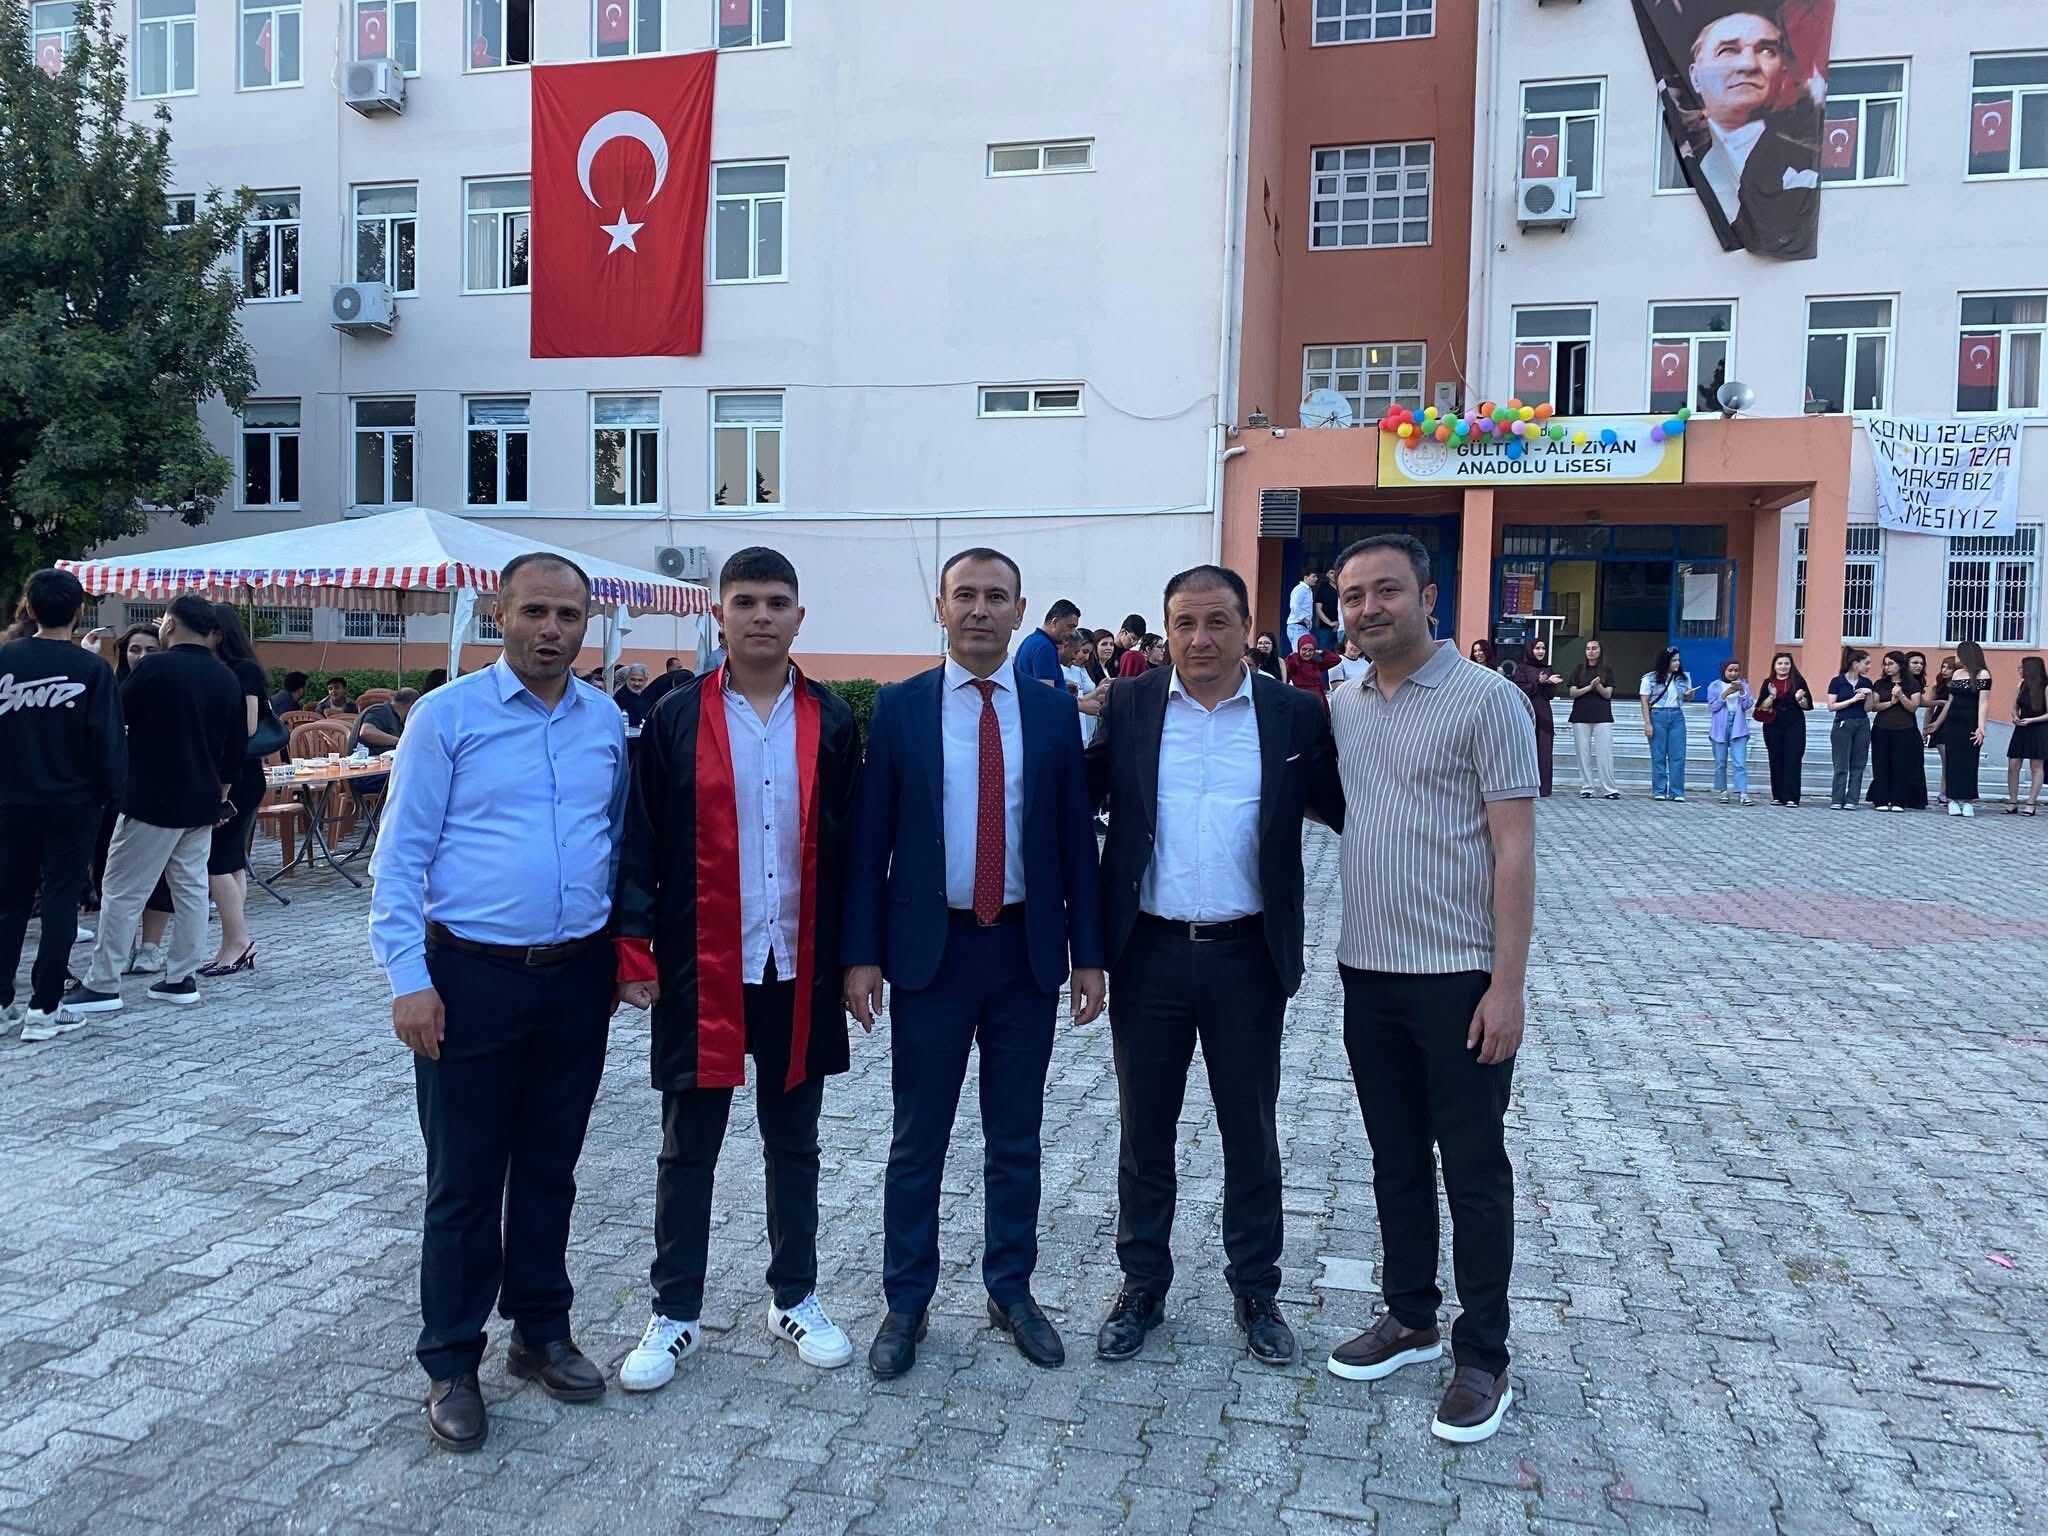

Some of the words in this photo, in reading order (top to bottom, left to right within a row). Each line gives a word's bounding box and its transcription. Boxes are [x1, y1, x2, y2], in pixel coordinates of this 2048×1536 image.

[1869, 418, 1929, 443] KONU
[1969, 447, 2010, 467] 12/A
[1457, 460, 1547, 475] ANADOLU
